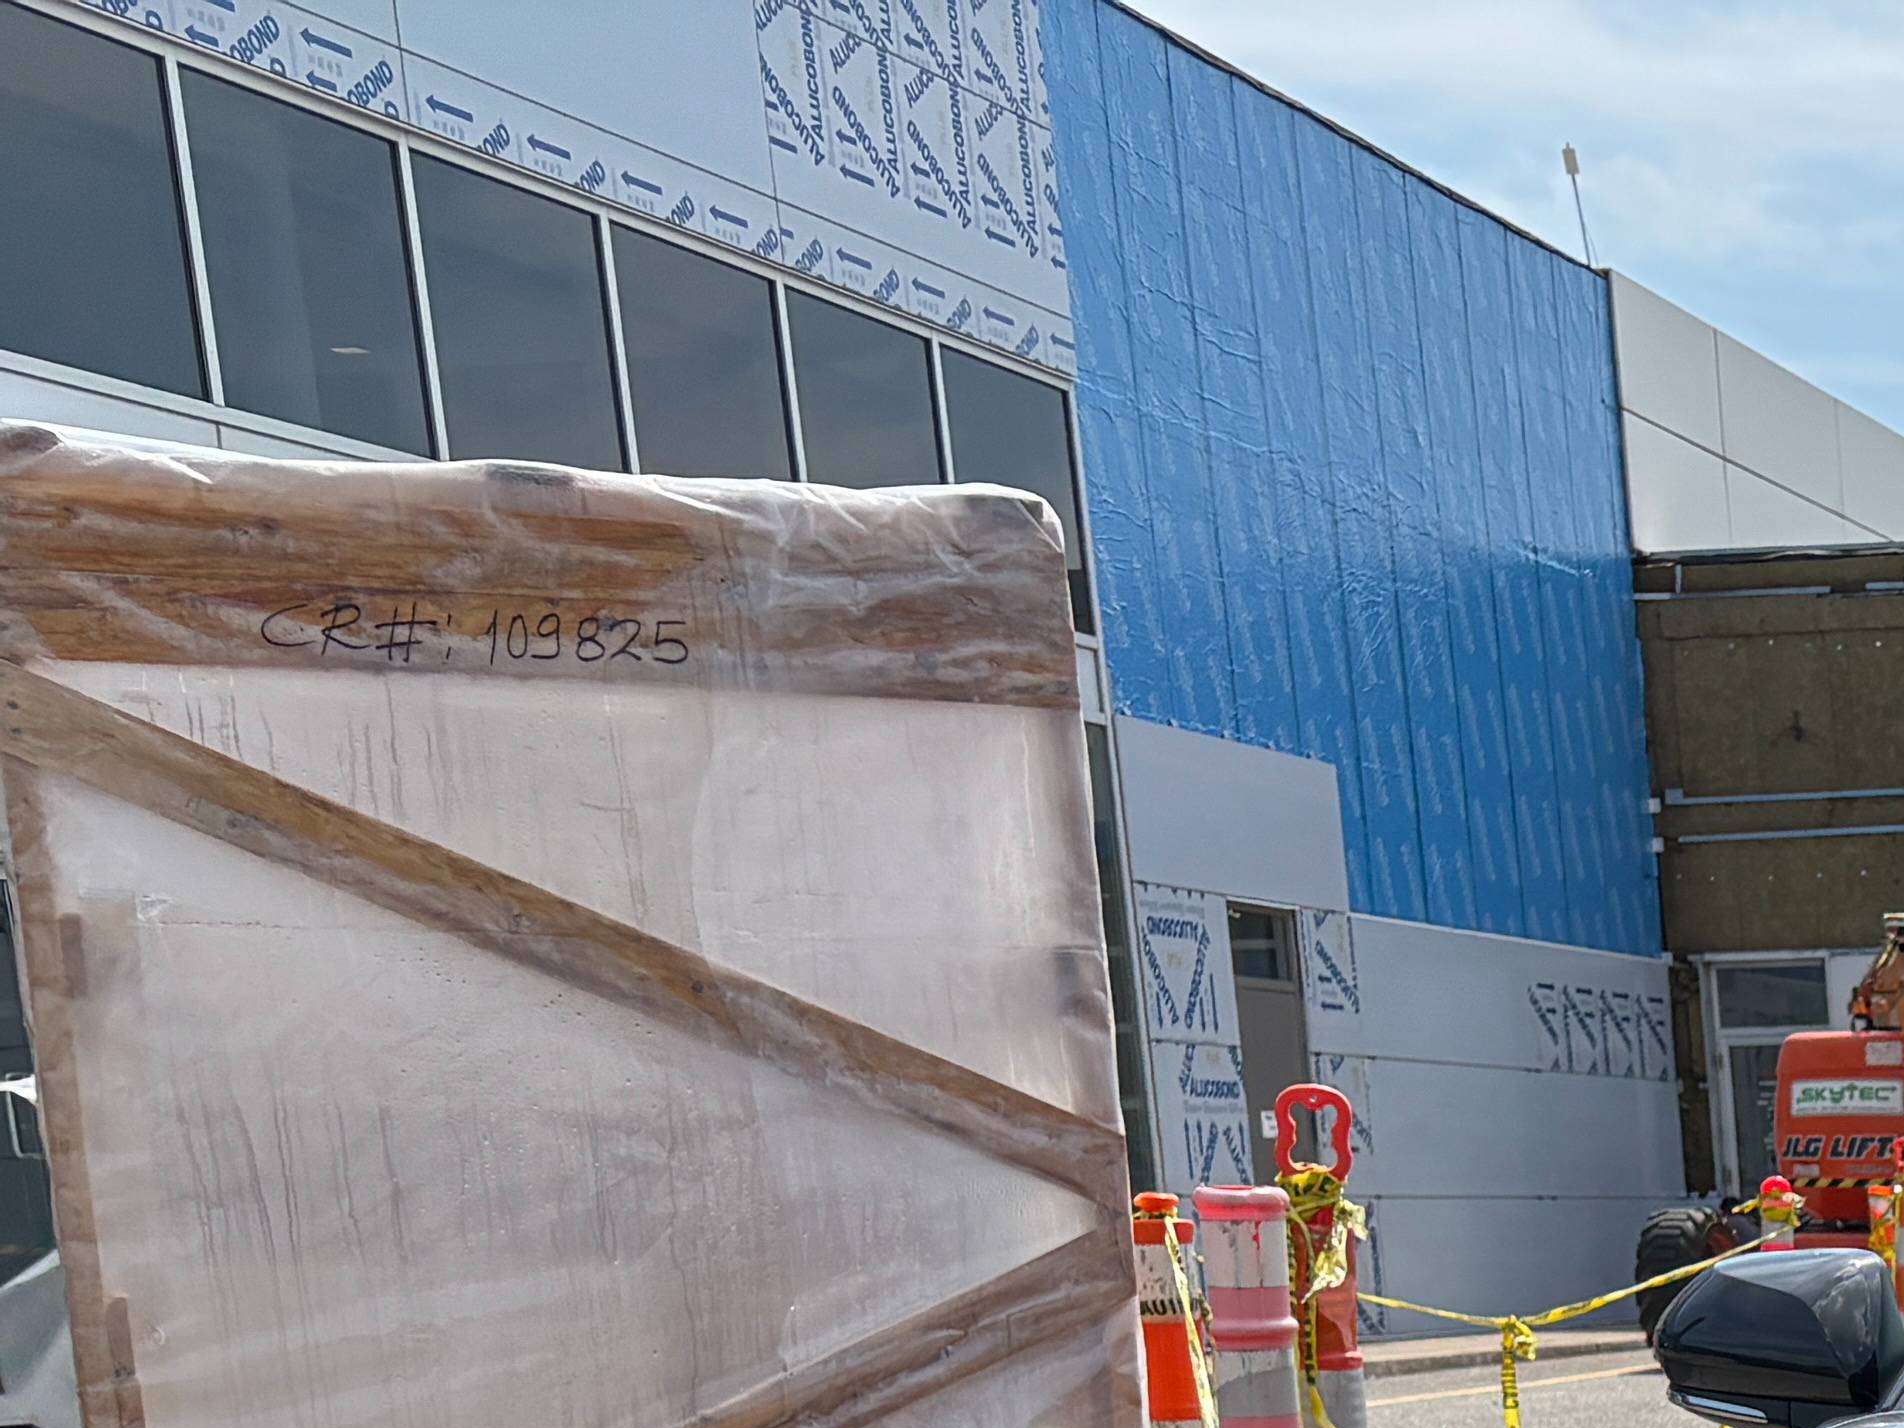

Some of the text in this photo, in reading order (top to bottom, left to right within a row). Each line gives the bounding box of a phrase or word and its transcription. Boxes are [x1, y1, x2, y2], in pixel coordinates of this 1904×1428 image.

[486, 608, 690, 666] 109825
[1798, 1081, 1896, 1105] SKYTEC
[1783, 1136, 1895, 1160] JLG LIFT
